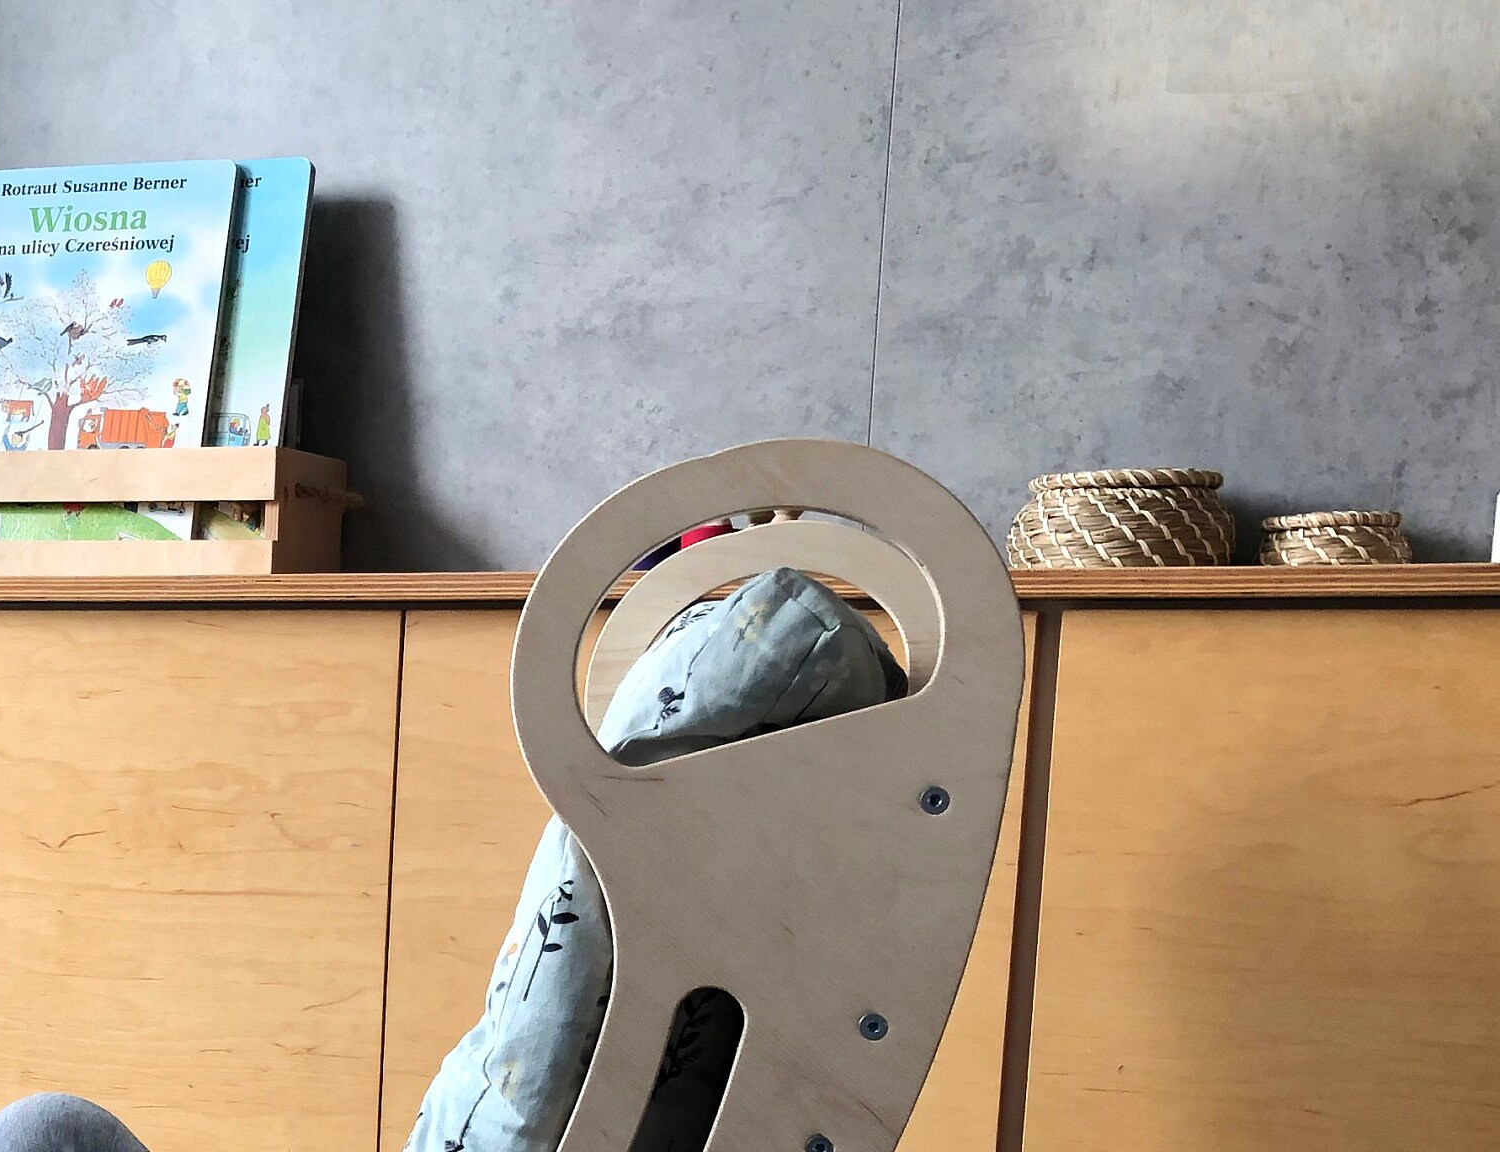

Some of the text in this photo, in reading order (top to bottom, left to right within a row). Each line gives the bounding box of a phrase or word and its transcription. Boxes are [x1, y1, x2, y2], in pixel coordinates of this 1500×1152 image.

[1, 176, 188, 197] Rotraut Susanne Berner
[29, 205, 147, 234] Wiosna
[21, 239, 60, 257] ulicy
[65, 234, 175, 254] Czereśniowej
